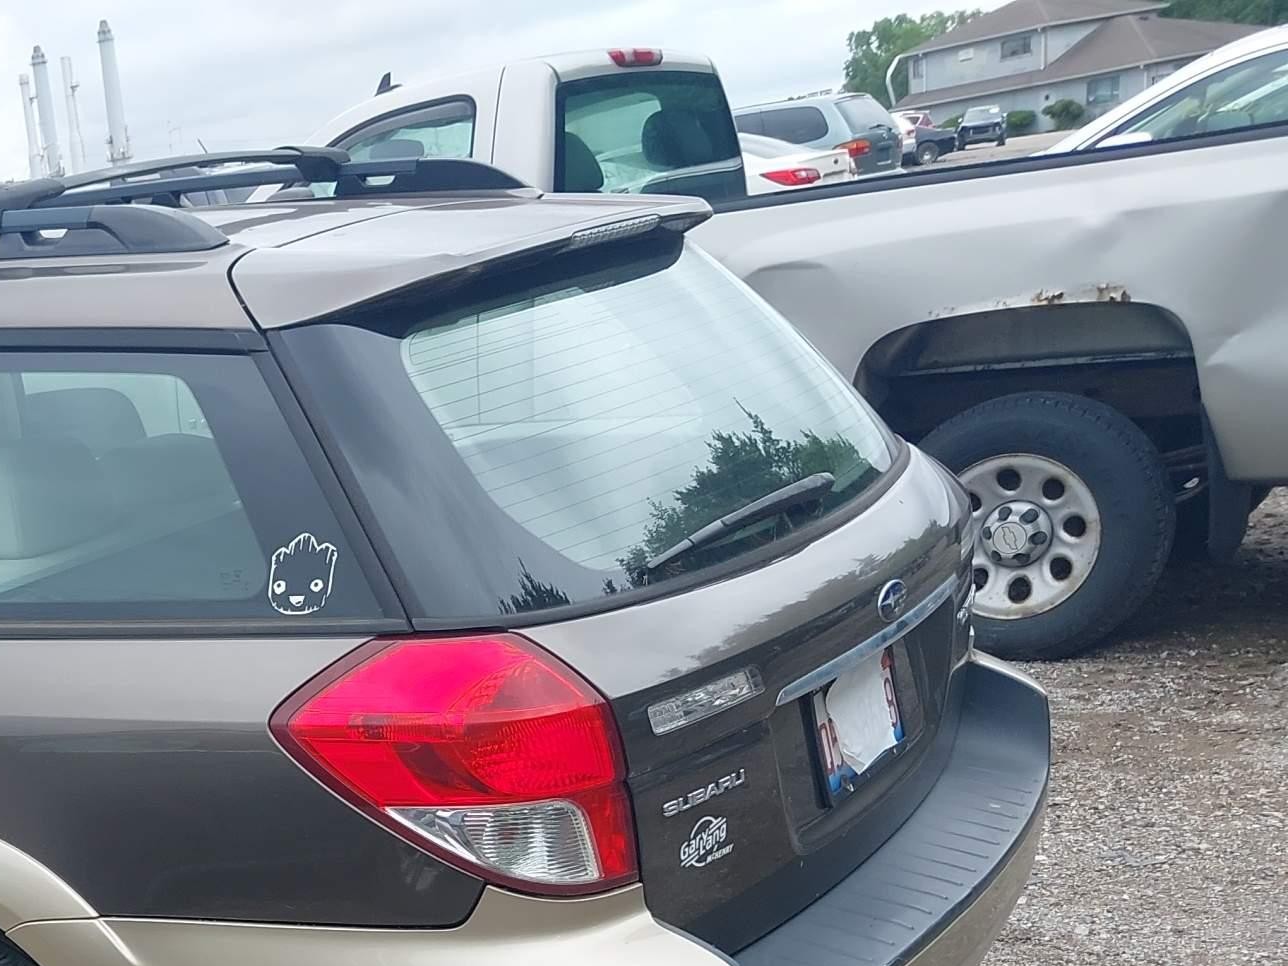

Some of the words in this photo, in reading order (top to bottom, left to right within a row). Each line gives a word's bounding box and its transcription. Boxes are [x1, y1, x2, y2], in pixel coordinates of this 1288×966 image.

[662, 768, 745, 817] SUBARU
[680, 828, 710, 860] Gary
[699, 823, 727, 856] Lang
